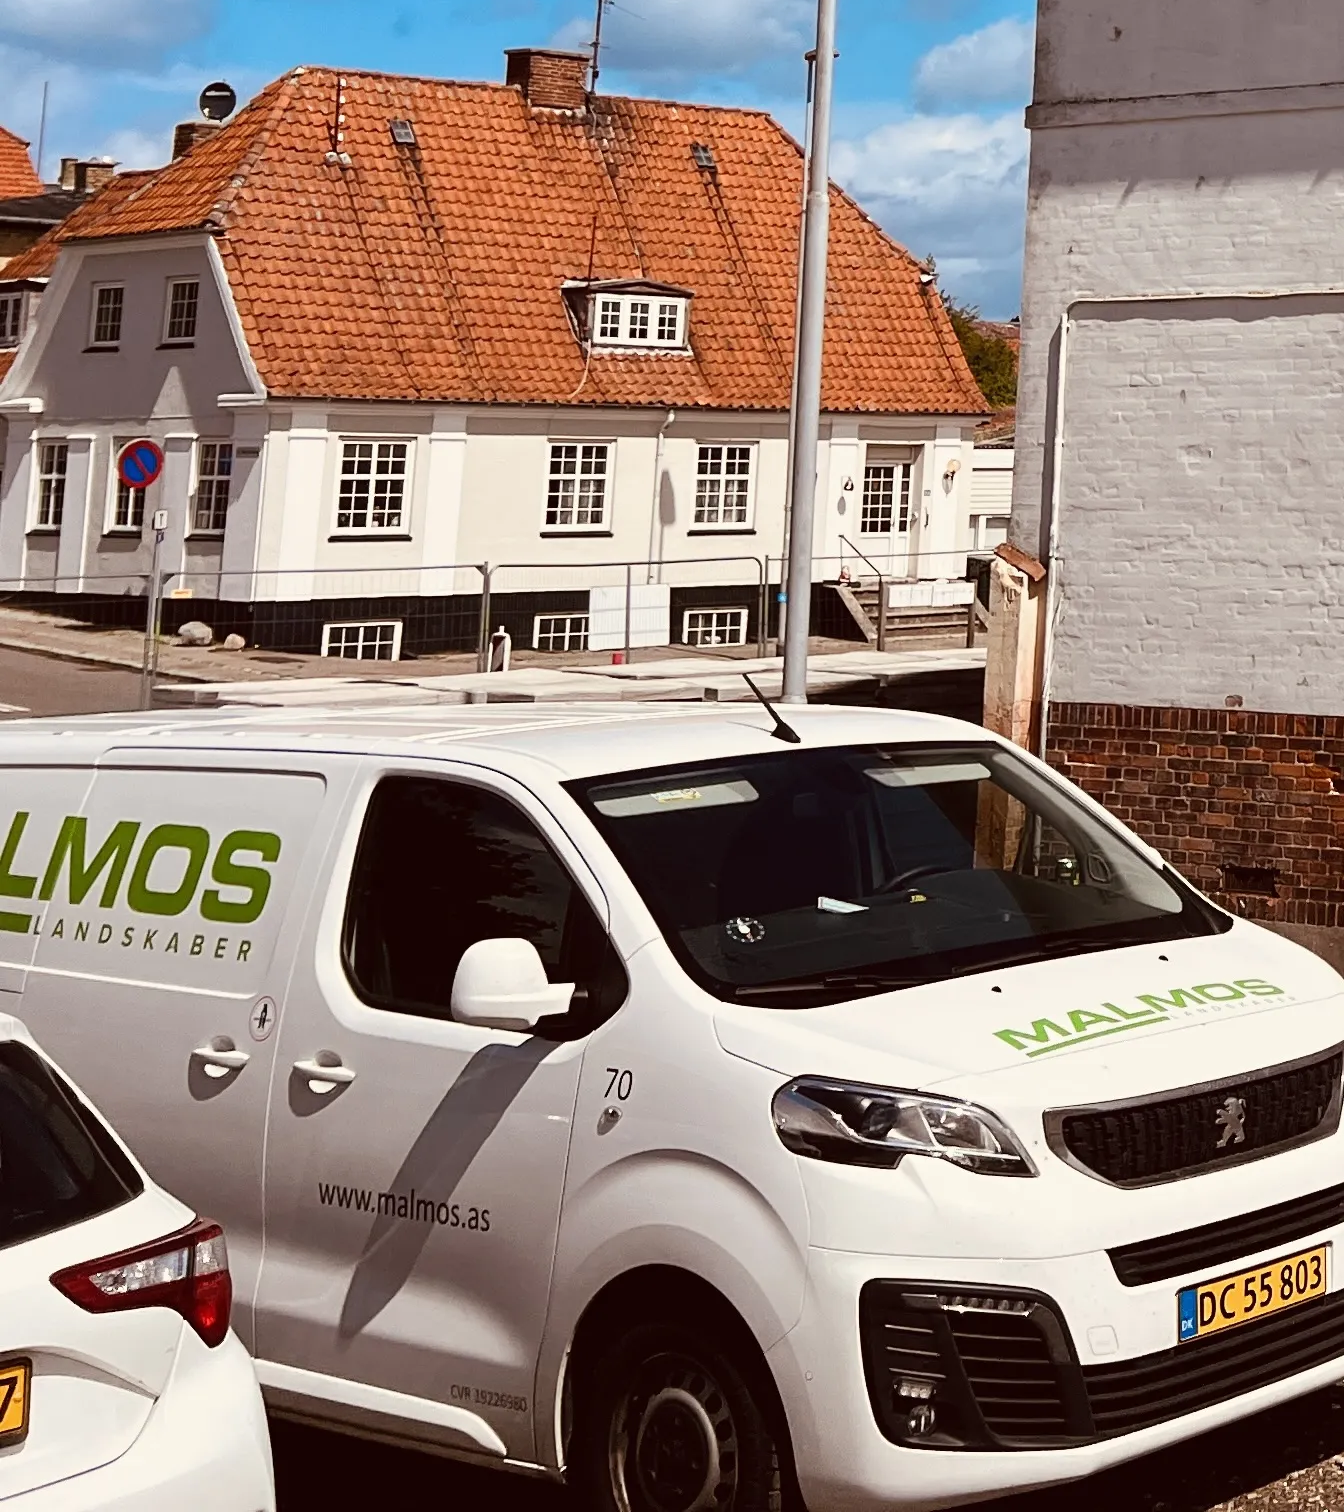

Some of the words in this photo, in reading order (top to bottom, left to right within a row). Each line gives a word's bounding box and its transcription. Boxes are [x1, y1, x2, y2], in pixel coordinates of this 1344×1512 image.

[33, 916, 253, 962] LANDSKABER
[992, 978, 1285, 1051] MALMOS
[604, 1068, 634, 1101] 70
[318, 1182, 491, 1232] www.malmos.as
[1181, 1318, 1194, 1332] DK
[1200, 1283, 1237, 1327] DC
[1244, 1271, 1273, 1313] 55
[1280, 1255, 1322, 1300] 803
[450, 1384, 471, 1401] CVR
